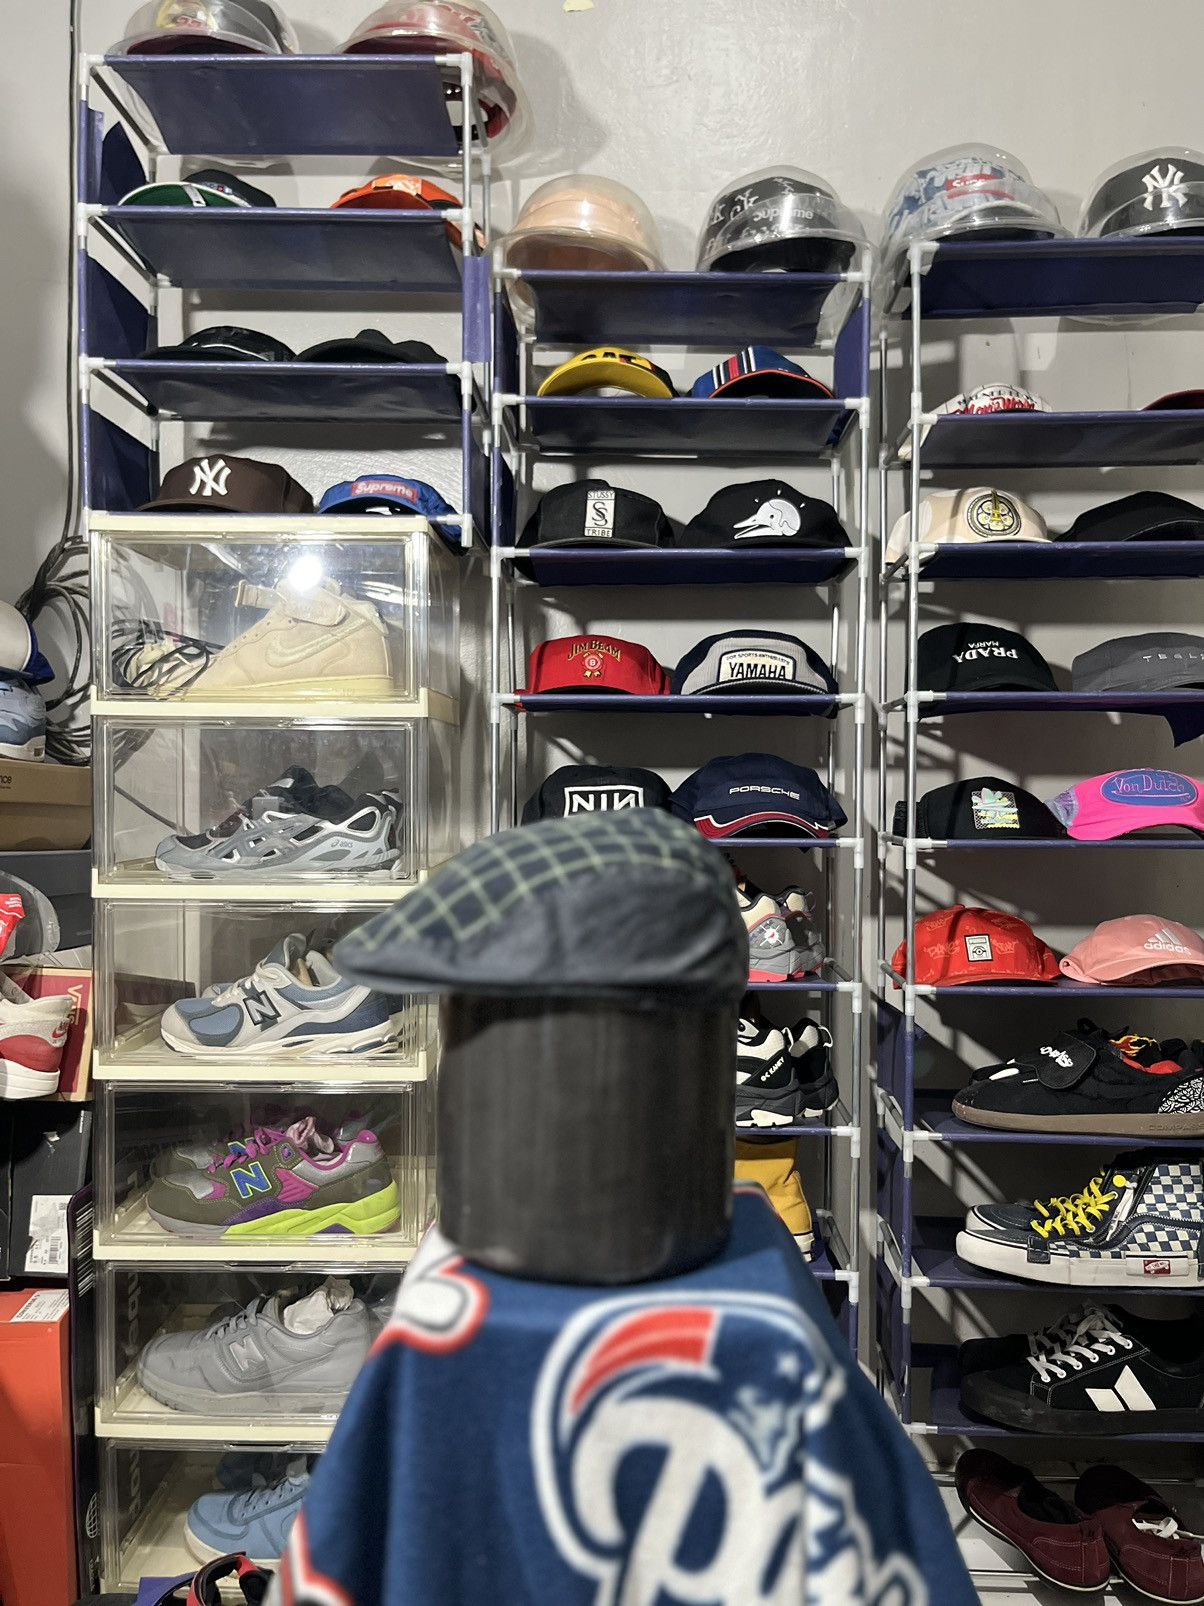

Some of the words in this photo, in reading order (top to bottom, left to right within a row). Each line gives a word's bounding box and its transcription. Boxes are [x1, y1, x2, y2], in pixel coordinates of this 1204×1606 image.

[189, 458, 231, 496] NY
[355, 481, 414, 497] Supreme
[587, 529, 612, 537] TRIBE
[567, 643, 589, 661] JIM
[592, 640, 621, 662] BEAM
[968, 640, 999, 649] MARFA
[952, 647, 1018, 663] PRADA
[729, 661, 786, 679] YAMAHA
[729, 785, 800, 801] PORSCHE
[1112, 776, 1142, 794] Von
[1143, 941, 1192, 956] adidas
[230, 1161, 272, 1198] N
